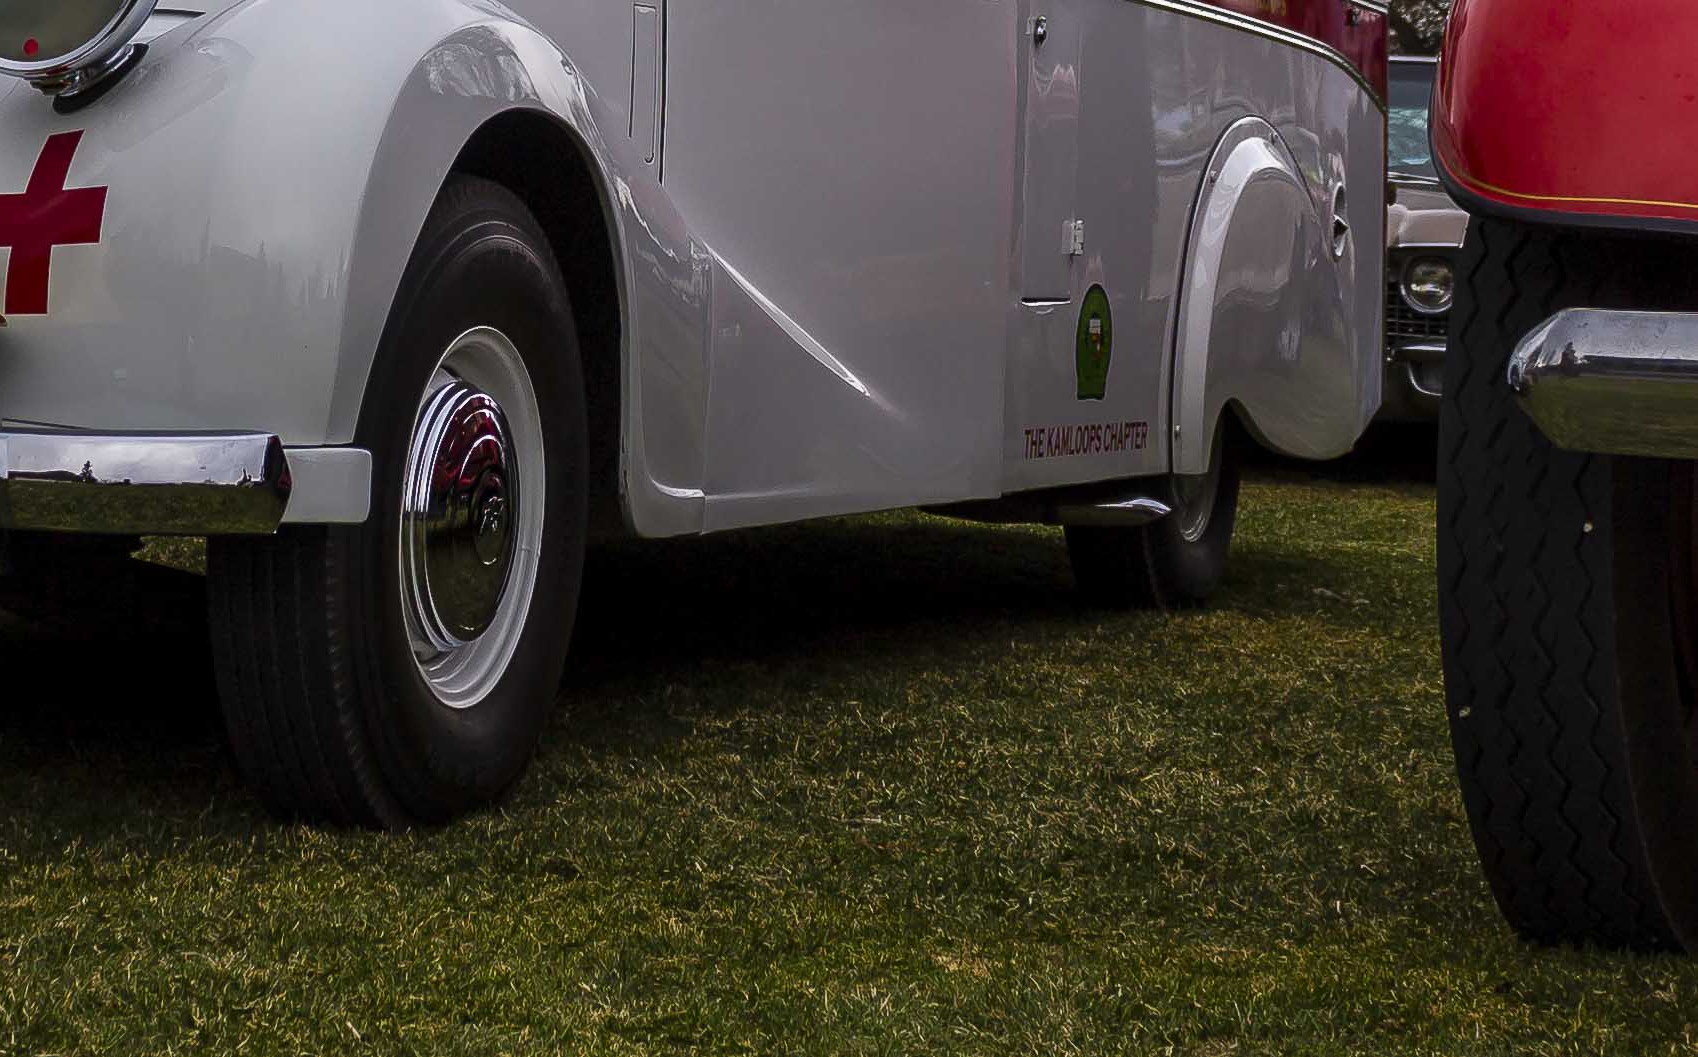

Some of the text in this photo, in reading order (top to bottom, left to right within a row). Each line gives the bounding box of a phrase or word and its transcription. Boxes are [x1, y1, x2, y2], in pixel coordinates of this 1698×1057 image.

[1024, 421, 1149, 460] THE KAMLOOPS CHAPTER
